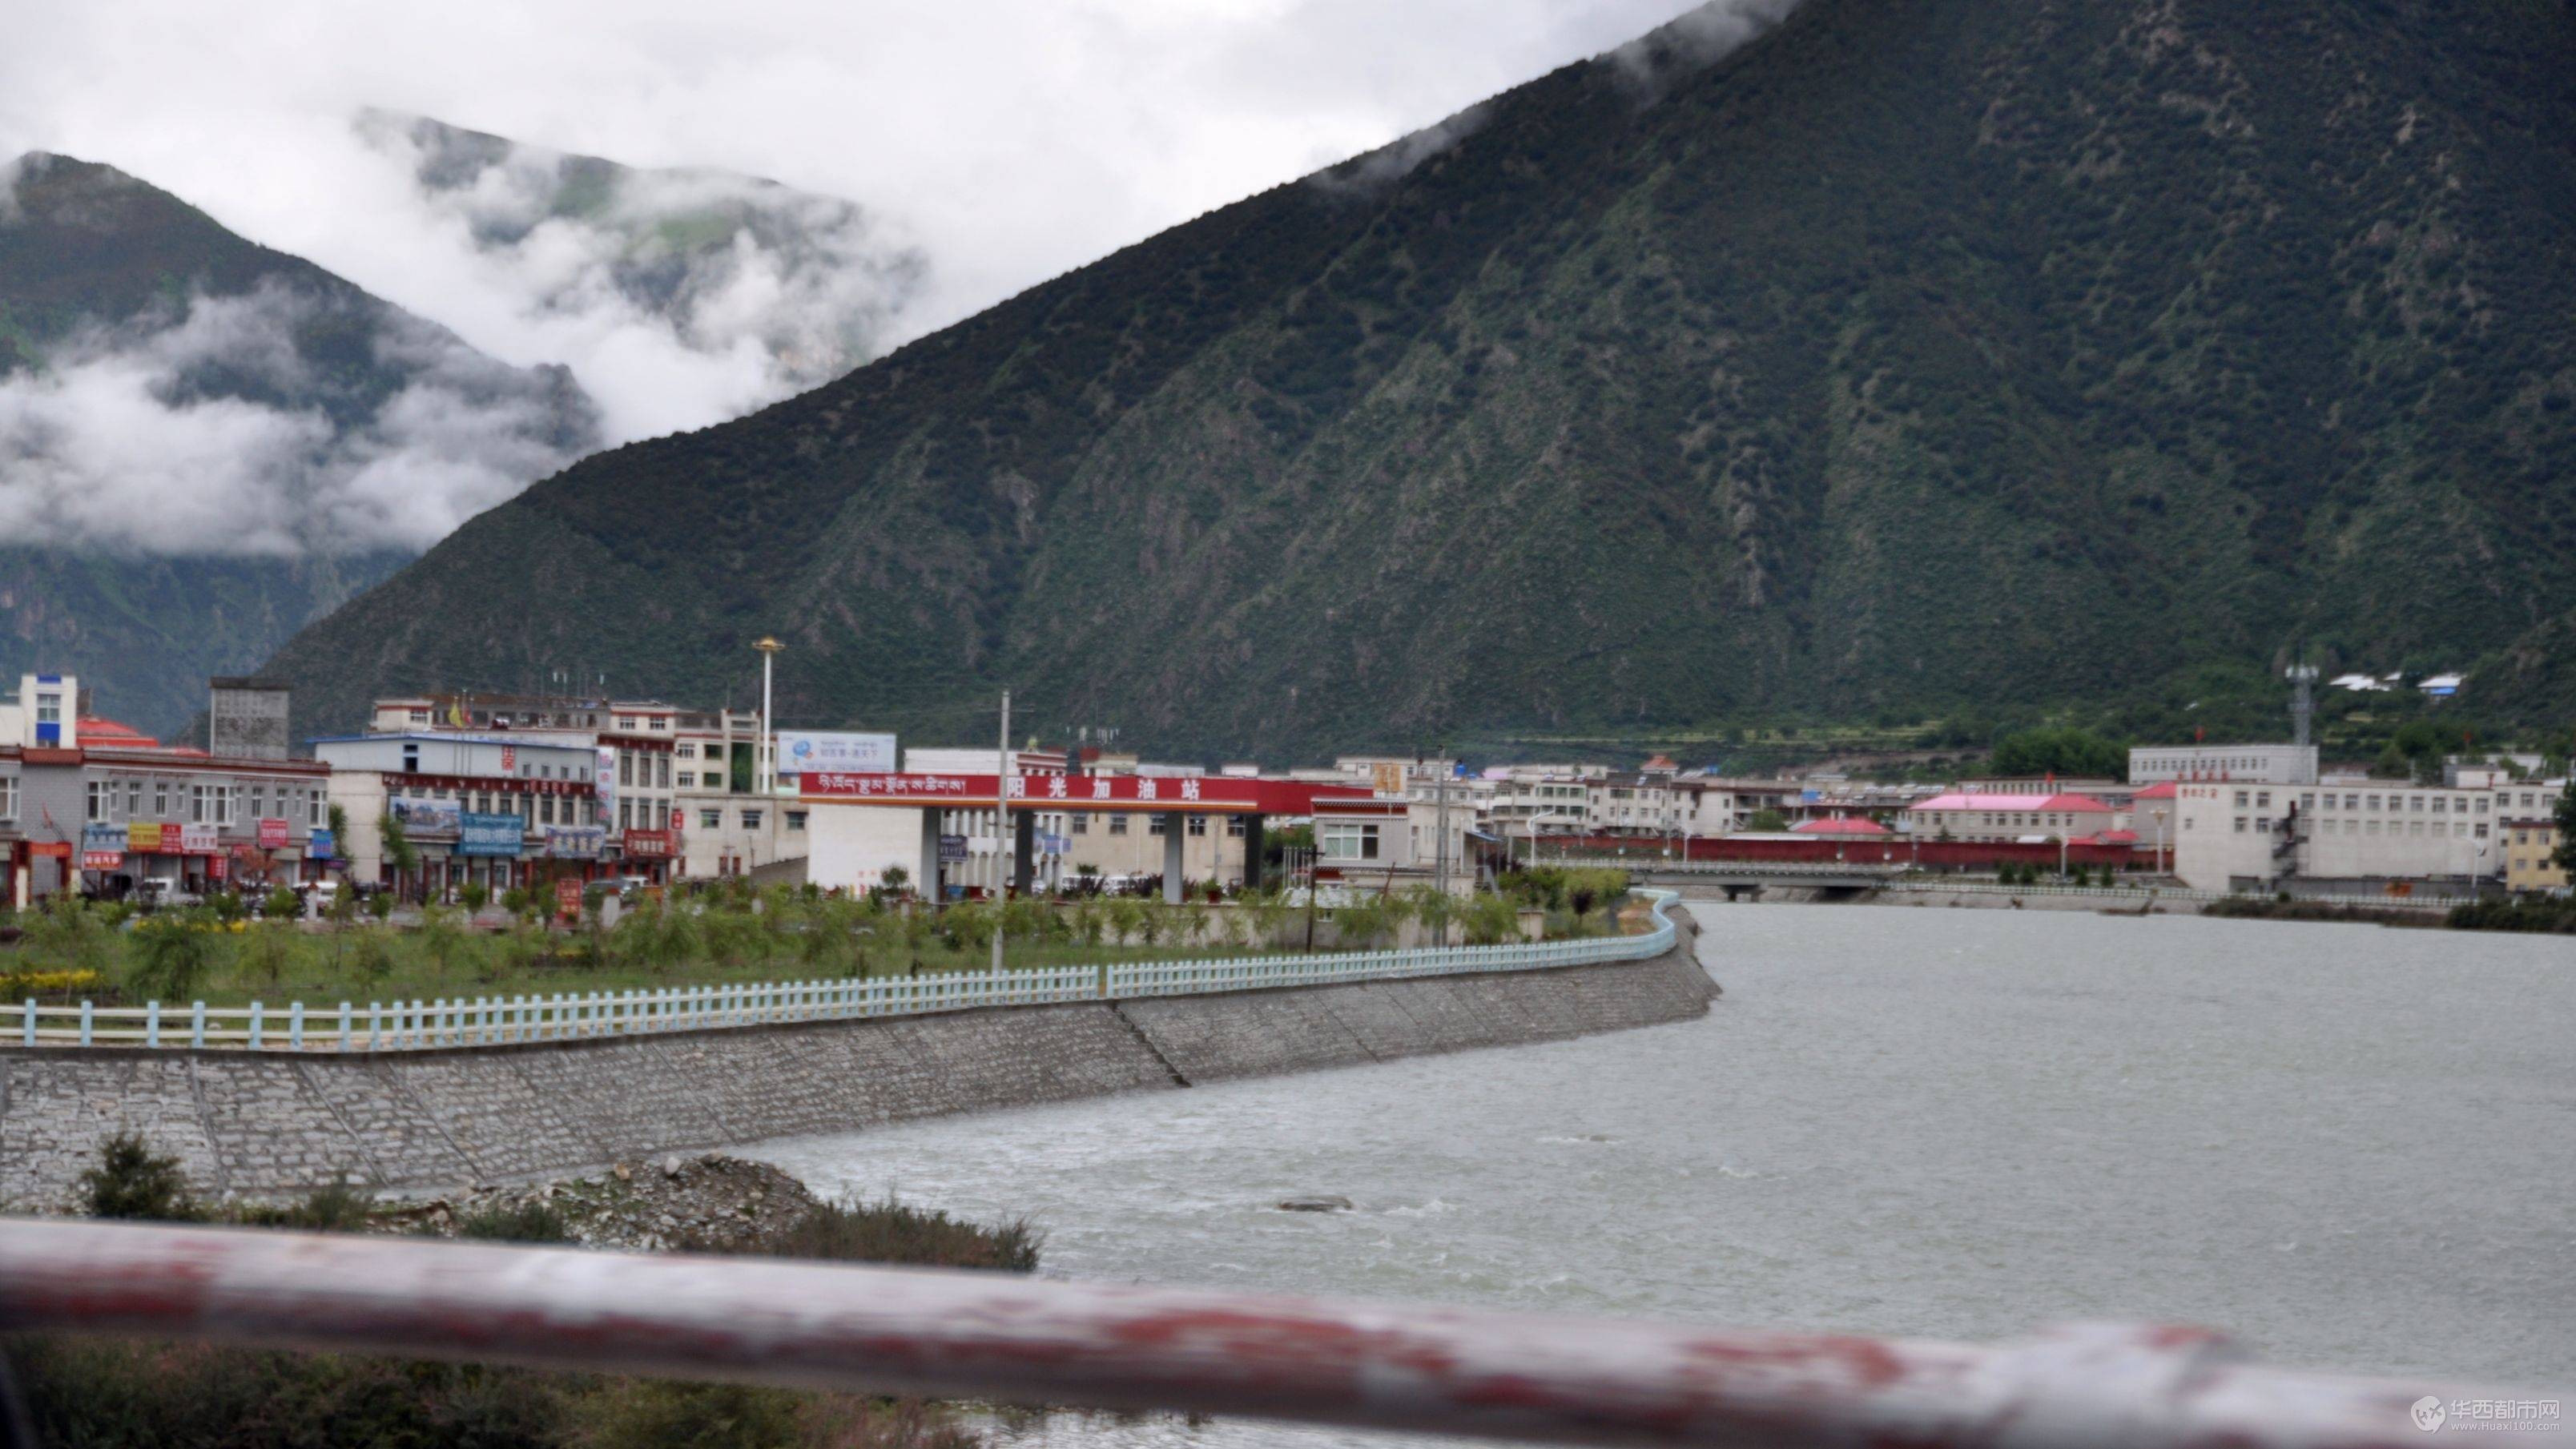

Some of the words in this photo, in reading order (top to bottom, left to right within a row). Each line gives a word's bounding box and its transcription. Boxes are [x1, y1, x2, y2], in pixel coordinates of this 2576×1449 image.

[1006, 776, 1201, 800] 阳光加油站
